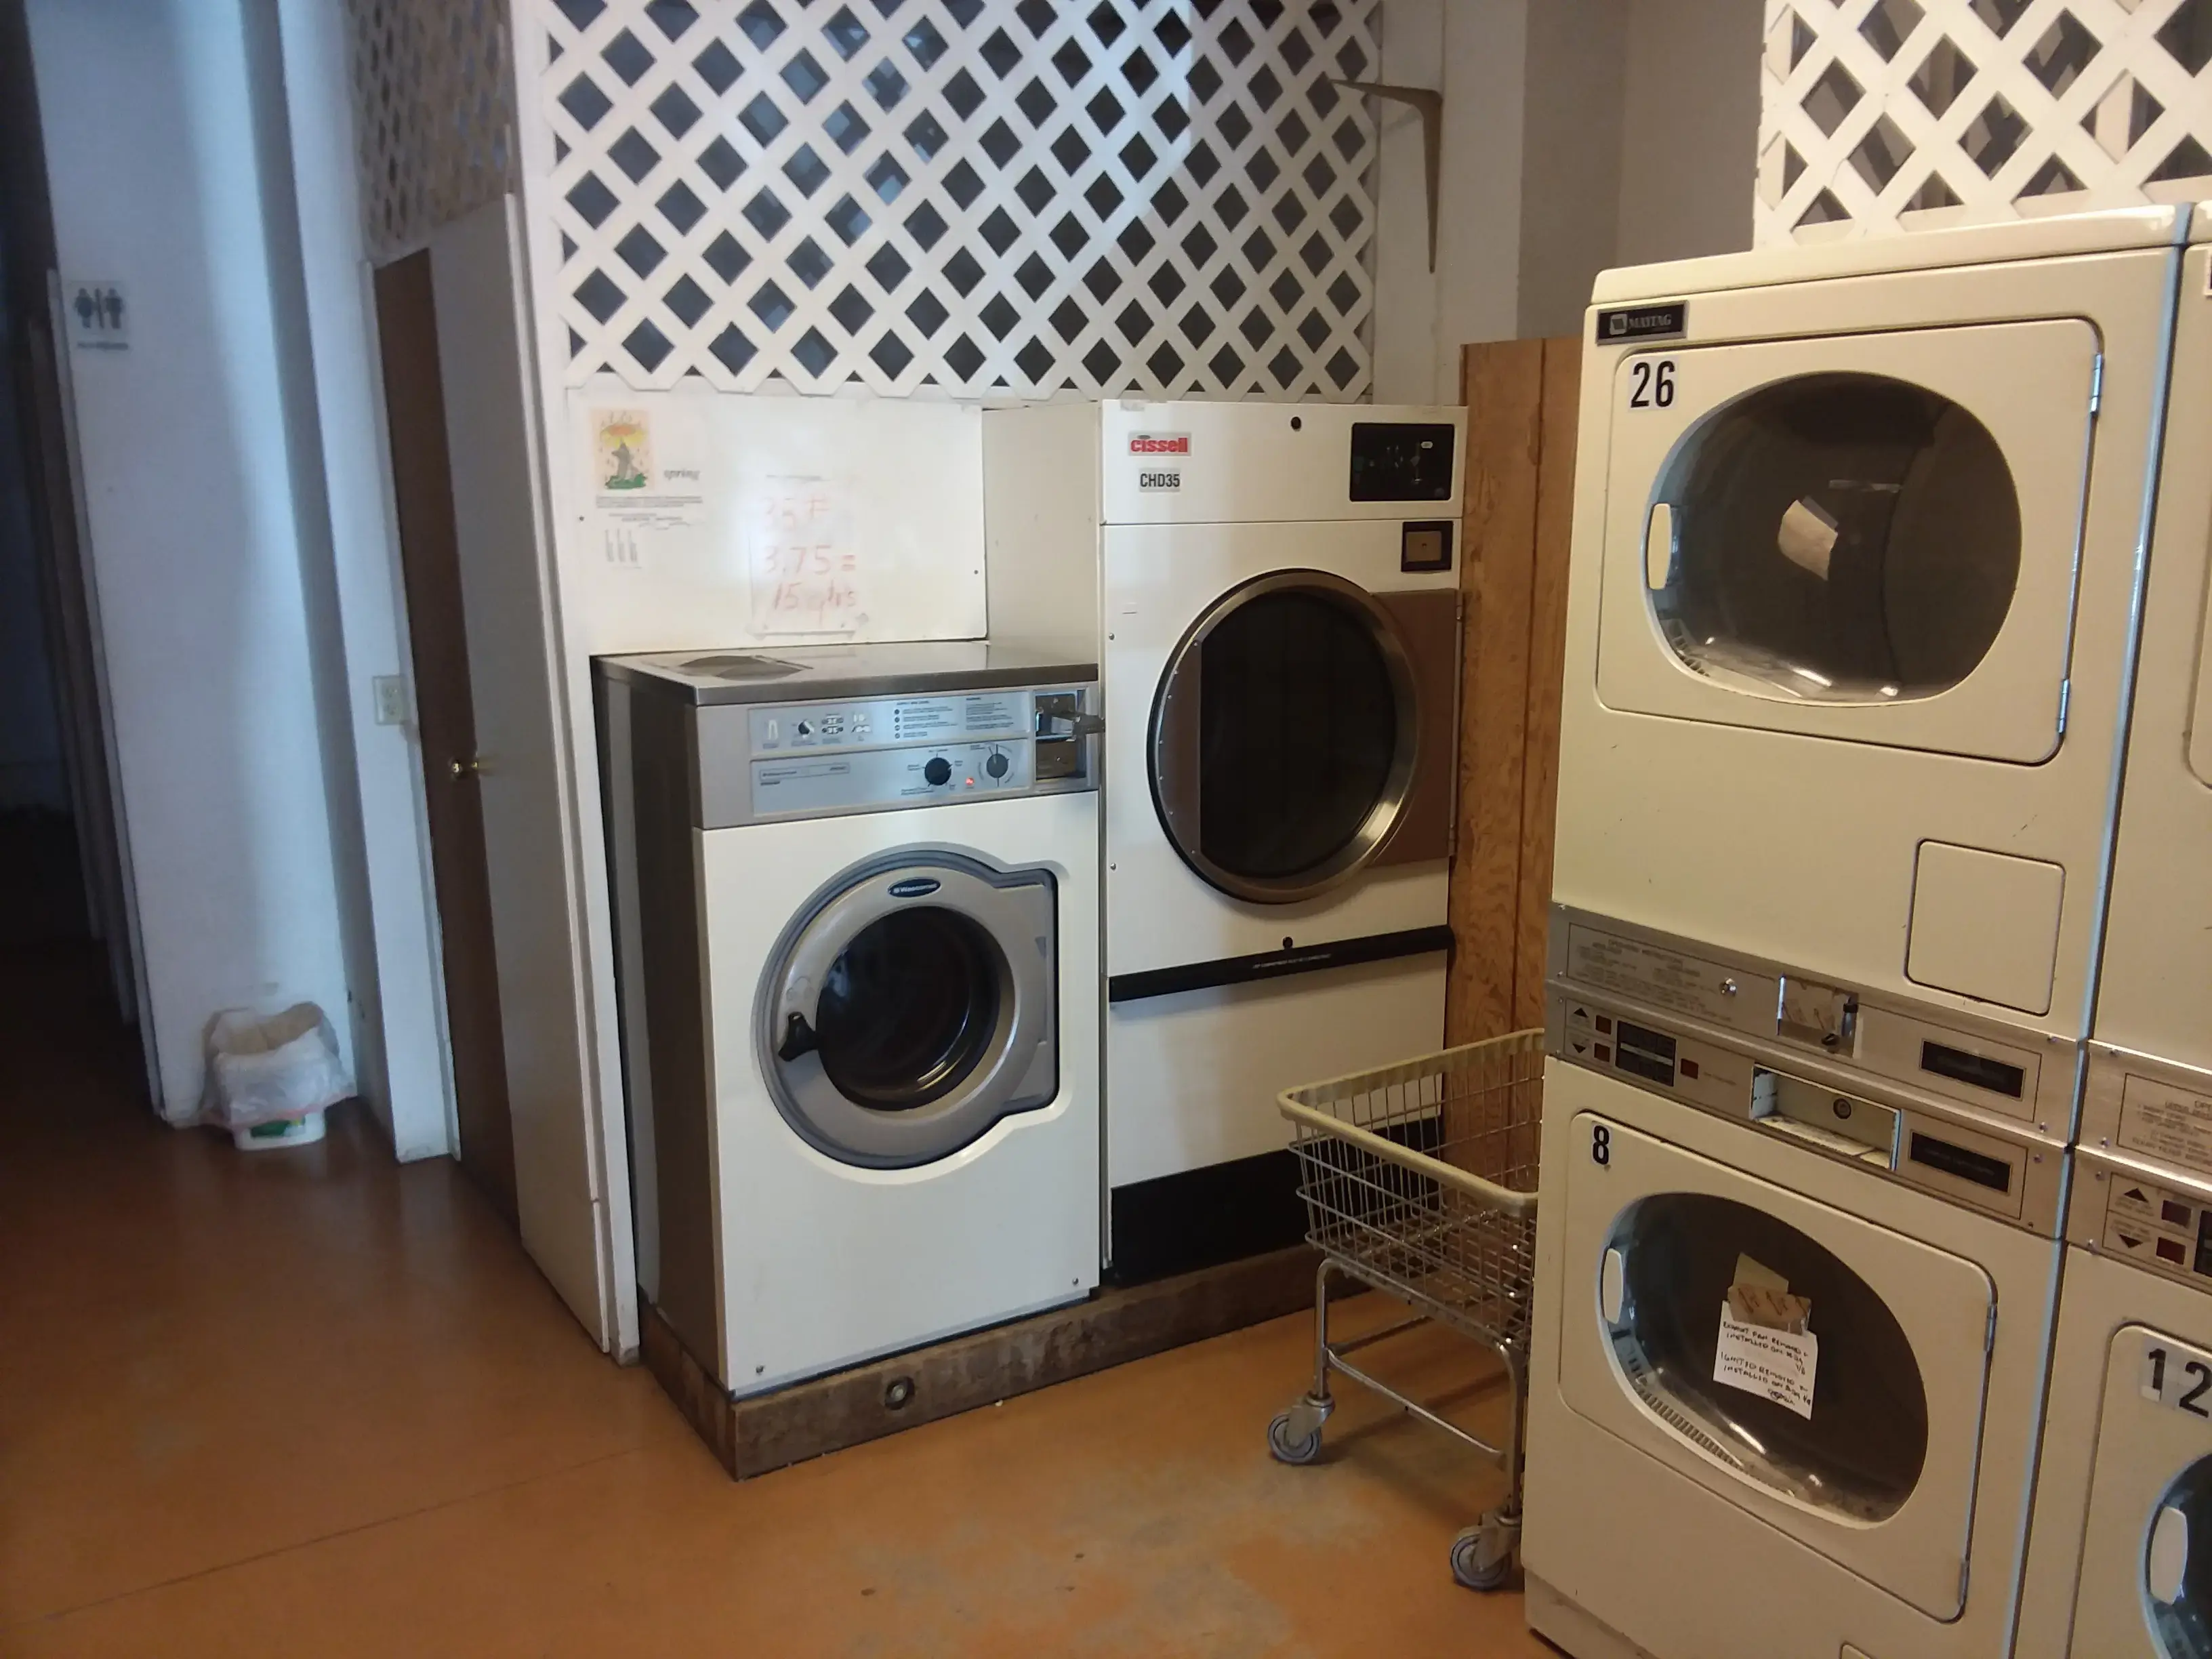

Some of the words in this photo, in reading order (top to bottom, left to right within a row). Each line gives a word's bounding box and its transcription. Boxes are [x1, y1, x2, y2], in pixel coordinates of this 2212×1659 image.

[1628, 313, 1672, 329] MAYTAG
[1630, 360, 1676, 408] 26
[1130, 435, 1188, 452] cissell
[1139, 472, 1181, 488] CHD35
[1593, 1126, 1610, 1165] 8
[2148, 1348, 2212, 1418] 12
